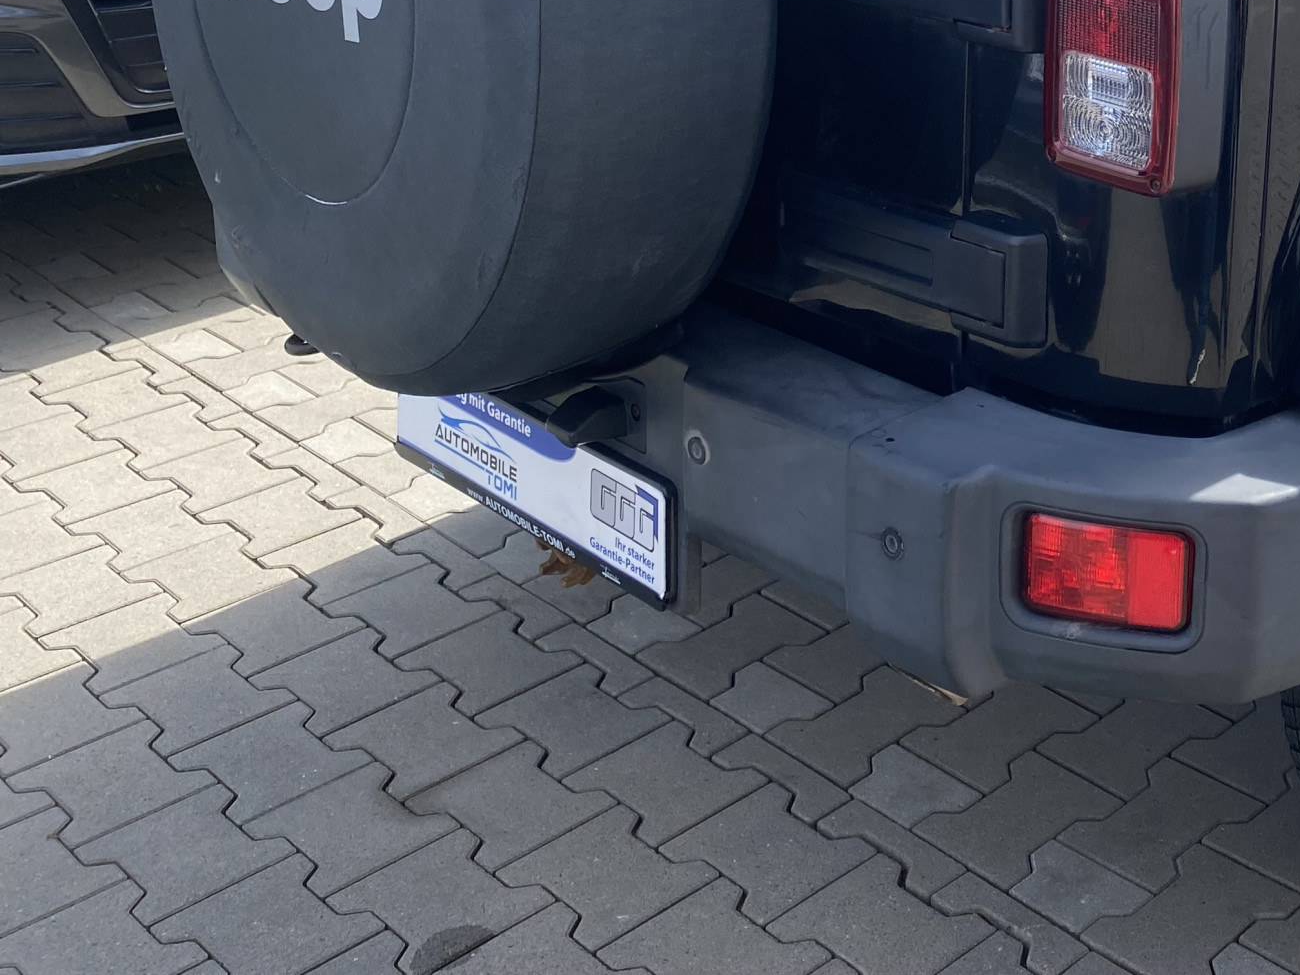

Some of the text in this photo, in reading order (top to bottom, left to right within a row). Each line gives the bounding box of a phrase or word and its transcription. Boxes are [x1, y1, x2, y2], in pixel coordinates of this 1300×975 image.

[469, 394, 486, 413] mit
[487, 402, 532, 438] Garantie
[435, 423, 518, 484] AUTOMOBILE
[486, 470, 518, 501] TOMI
[589, 536, 655, 585] Garantie-Partner
[615, 537, 655, 571] Ihr starker
